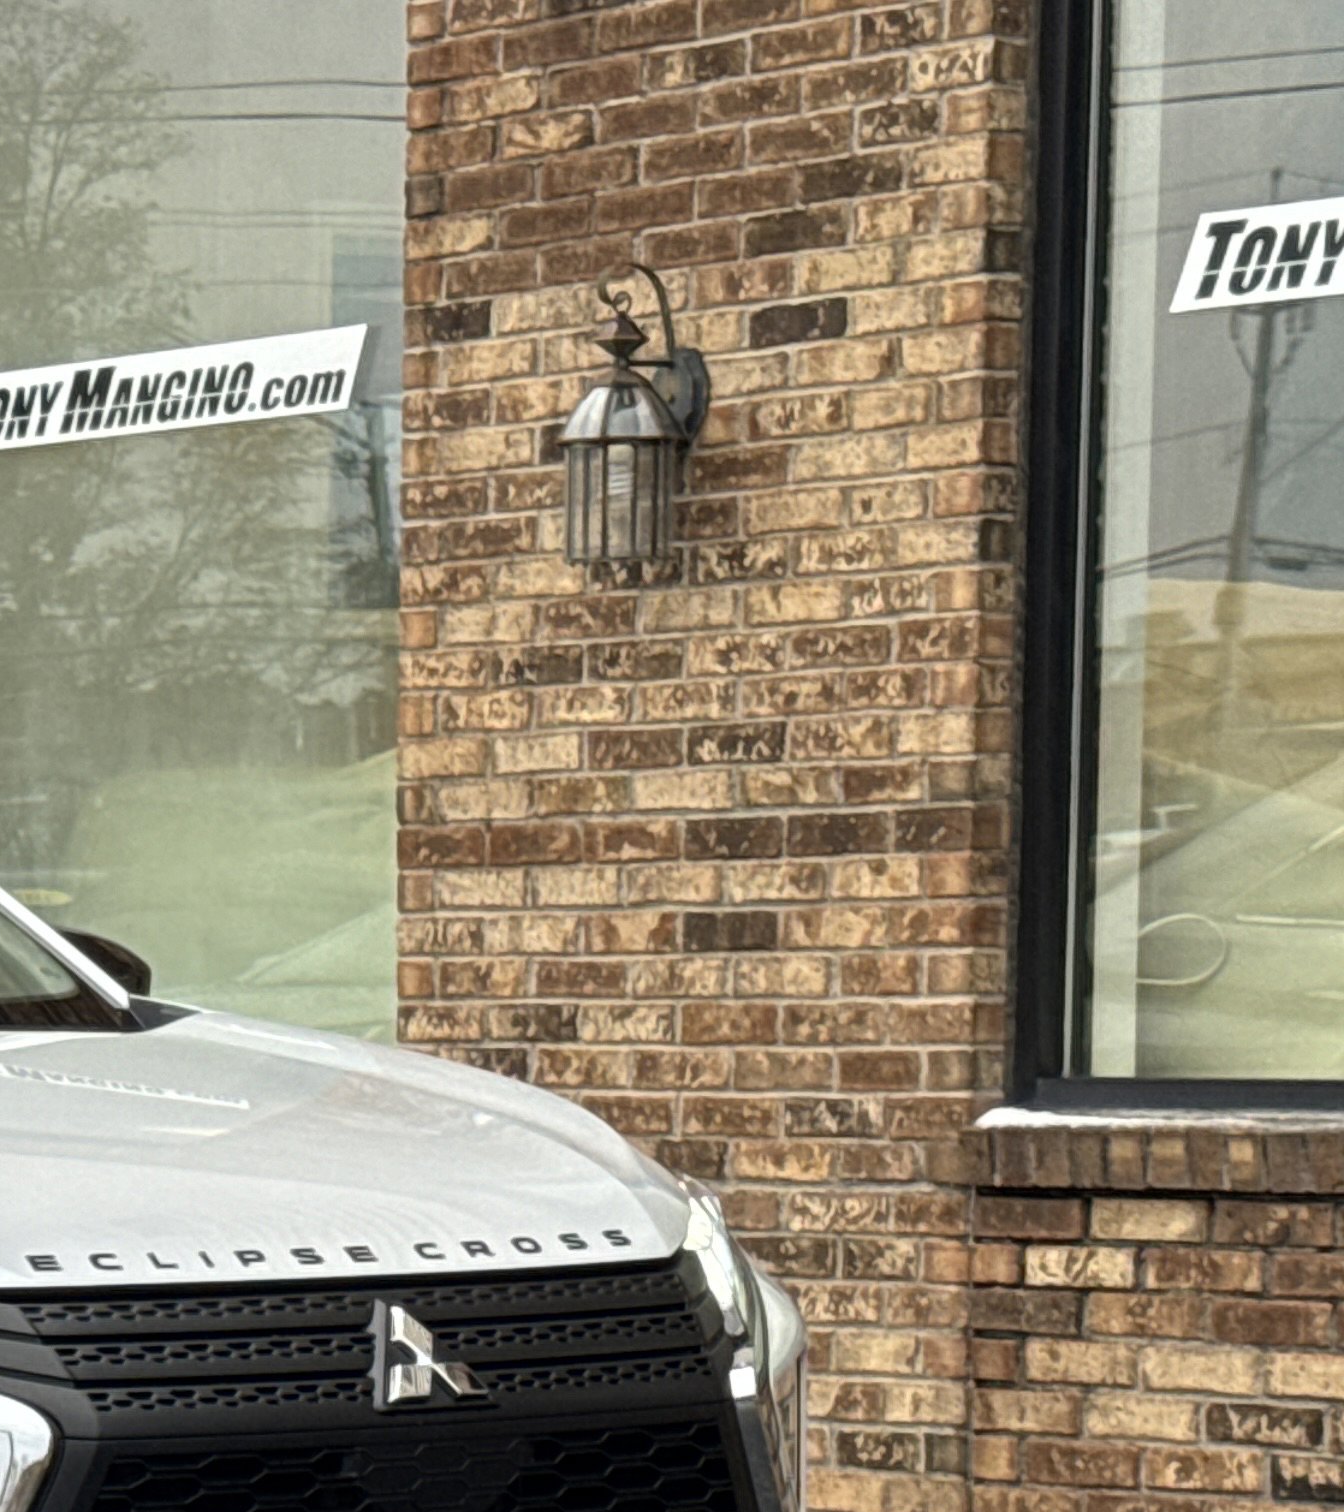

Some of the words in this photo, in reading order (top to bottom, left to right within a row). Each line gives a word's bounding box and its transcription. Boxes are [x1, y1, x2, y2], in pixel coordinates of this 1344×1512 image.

[1194, 218, 1344, 300] TONY
[59, 362, 347, 434] MANGINO.com
[25, 1245, 378, 1272] ECLIPSE
[413, 1229, 632, 1261] CROSS
